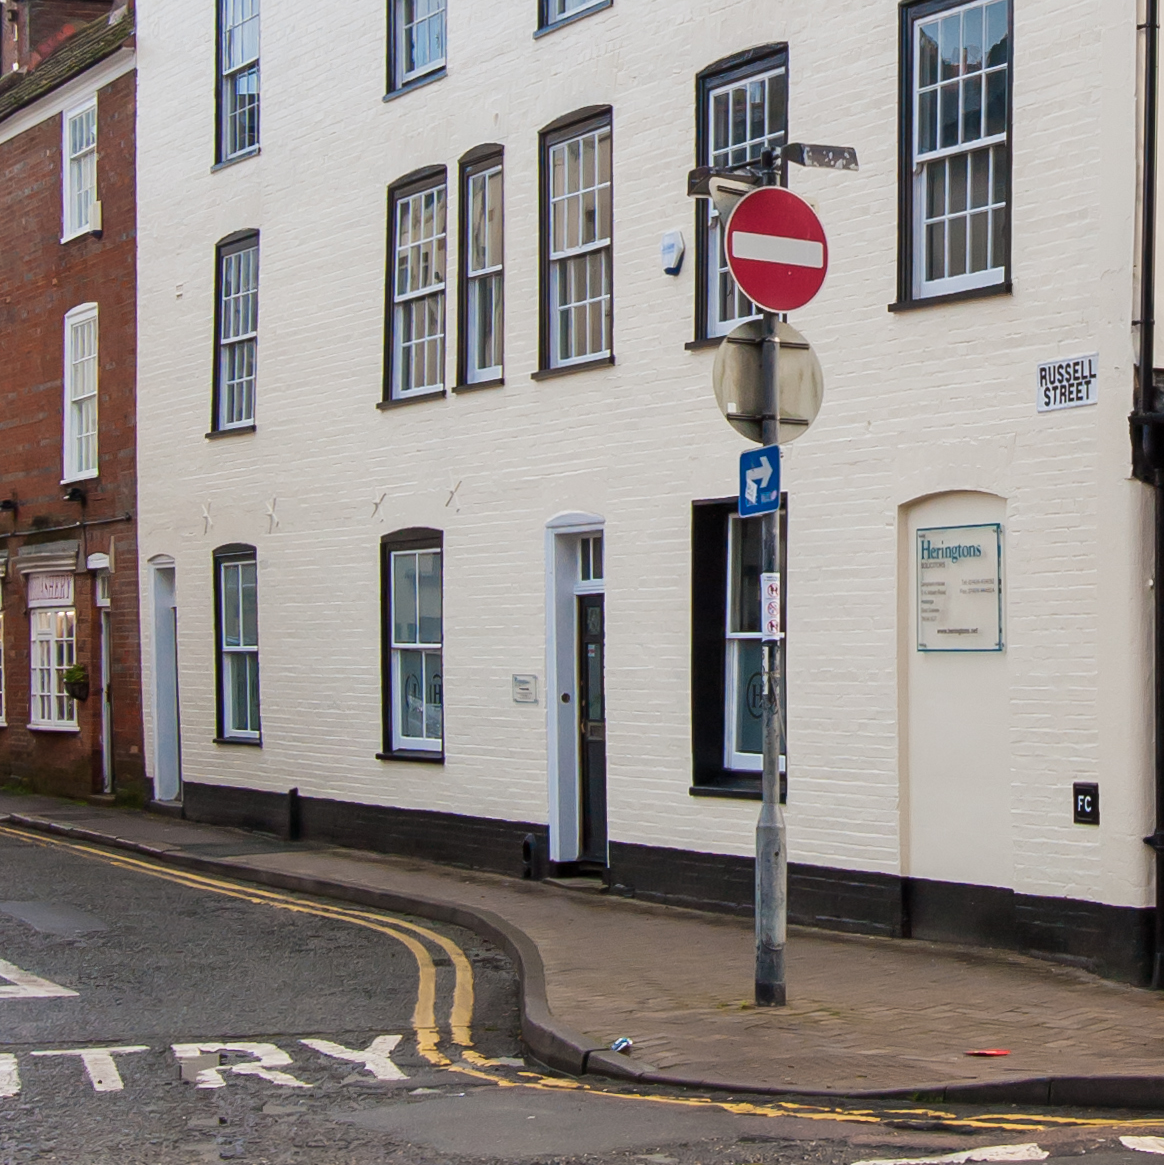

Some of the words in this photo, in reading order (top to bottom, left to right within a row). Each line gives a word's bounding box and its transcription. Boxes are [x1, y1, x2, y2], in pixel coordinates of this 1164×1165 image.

[1040, 359, 1097, 387] RUSSELL
[1044, 380, 1092, 407] STREET
[921, 540, 982, 564] Heringtons
[1077, 795, 1092, 813] FC
